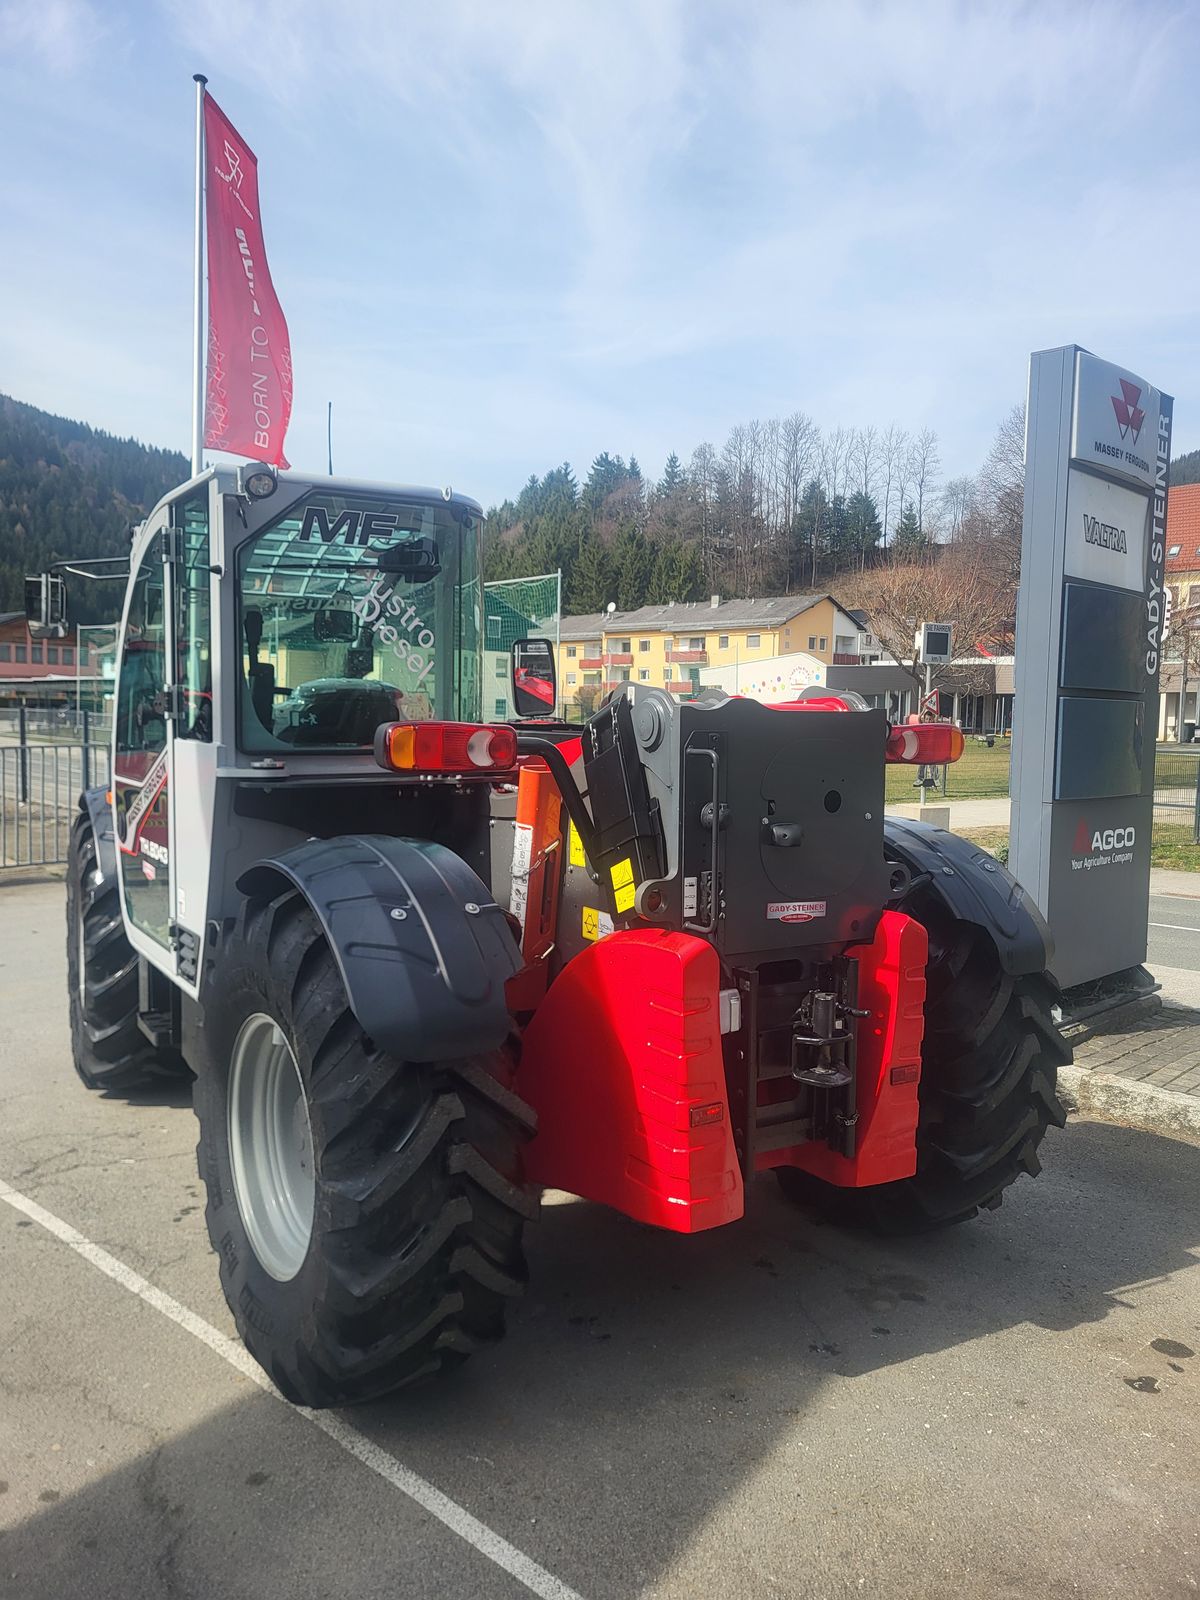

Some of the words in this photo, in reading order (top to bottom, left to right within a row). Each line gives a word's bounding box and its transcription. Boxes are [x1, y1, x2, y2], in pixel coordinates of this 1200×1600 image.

[251, 326, 269, 362] TO
[252, 372, 271, 449] BORN
[1094, 441, 1124, 460] MASSEY
[1125, 451, 1150, 473] FERGUSON
[299, 506, 399, 546] MF
[1083, 513, 1128, 554] VALTRA
[1145, 416, 1170, 676] GADY-STEINER
[355, 594, 435, 681] Diesel
[1091, 827, 1135, 851] AGCO
[1071, 859, 1084, 870] Your
[1084, 855, 1111, 870] Agriculture
[1112, 852, 1133, 864] Company
[769, 904, 824, 912] GADY-STEINER
